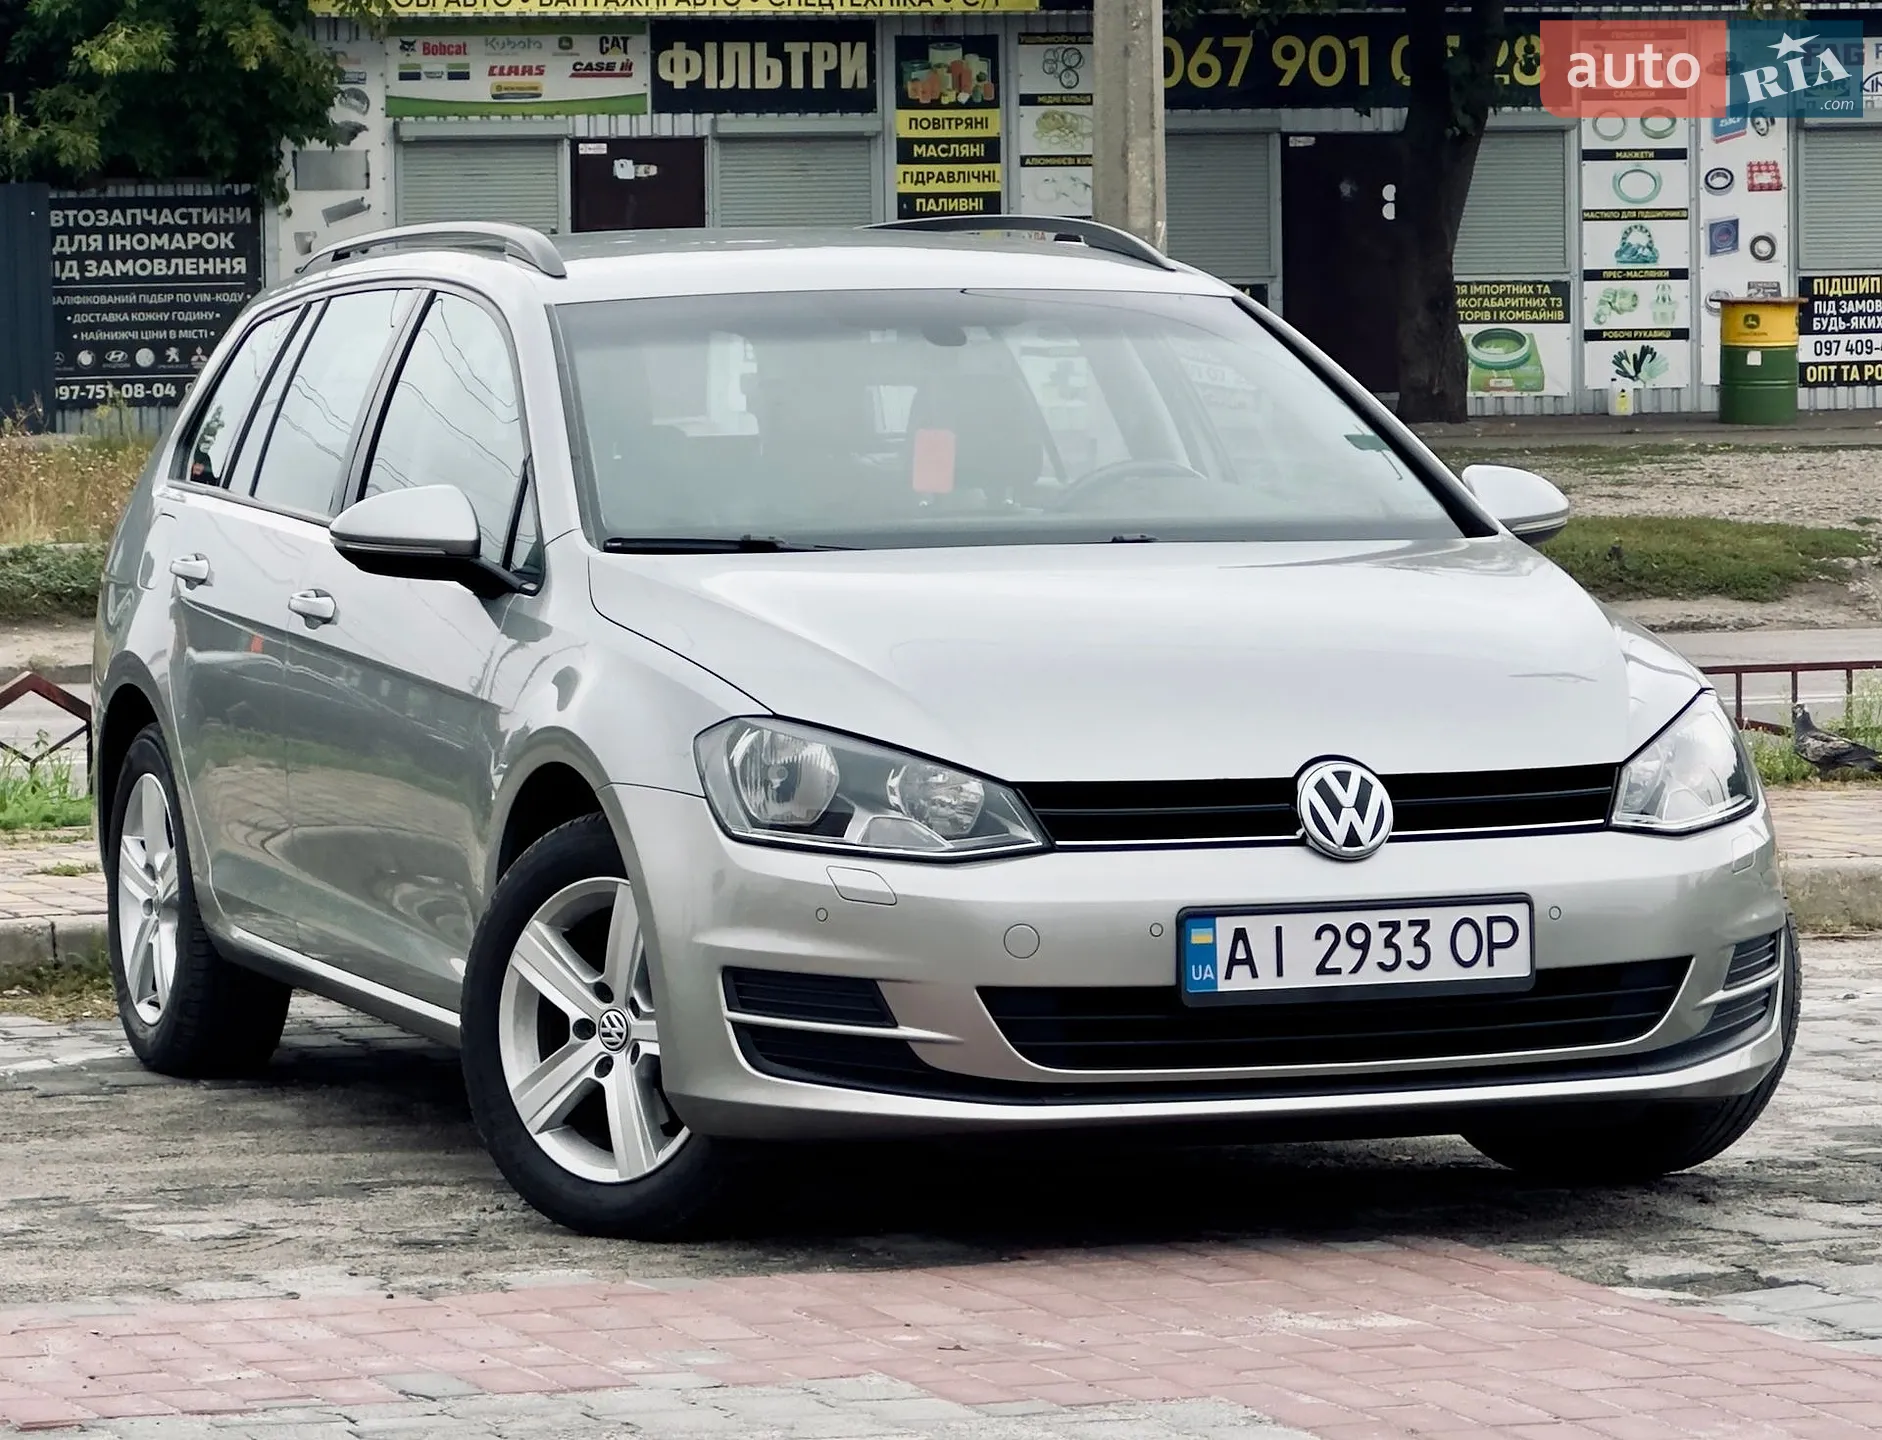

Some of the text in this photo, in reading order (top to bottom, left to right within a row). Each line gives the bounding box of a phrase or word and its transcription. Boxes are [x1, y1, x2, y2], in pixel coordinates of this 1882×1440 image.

[422, 41, 468, 56] Bobcat
[485, 36, 543, 50] Kubota
[600, 35, 631, 56] CAT
[572, 61, 617, 72] CASE
[658, 41, 868, 90] ФІЛЬТРИ
[1163, 35, 1253, 89] 067
[1272, 35, 1370, 88] 901
[488, 64, 546, 77] CLAAS
[909, 116, 989, 131] ПОВІТРЯНІ
[913, 143, 985, 158] МАСЛЯНІ
[1615, 151, 1655, 159] МАНЖЕТИ
[903, 170, 996, 187] ГІДРАВЛІЧНІ
[915, 198, 984, 212] ПАЛИВНІ
[50, 207, 251, 227] ВТОЗАПЧАСТИНИ
[1583, 211, 1620, 219] МАСТИЛО
[1621, 210, 1637, 219] ДЛЯ
[52, 232, 235, 255] ДЛЯ ІНОМАРОК
[51, 257, 247, 281] ІД ЗАМОВЛЕННЯ
[1602, 270, 1670, 279] ПРЕС-МАСЛЯНКИ
[1470, 284, 1534, 295] ІМПОРТНИХ
[1537, 284, 1551, 295] ТА
[1813, 277, 1882, 297] ПІДШИП
[53, 291, 244, 305] АЛІФІКОВАНИЙ ПІДБІР ПО VIN-КОДУ
[1493, 310, 1497, 320] І
[1499, 308, 1565, 321] КОМБАЙНІВ
[1813, 299, 1882, 315] ПІД ЗАМОВ
[72, 310, 215, 324] ДОСТАВКА КОЖНУ ГОДИНУ
[1812, 316, 1882, 332] БУДЬ-ЯКИХ
[80, 328, 208, 341] НАЙНИЖЧІ ЦІНИ В МІСТІ
[1602, 330, 1672, 339] РОБОЧІ РУКАВИЦІ
[1813, 339, 1882, 356] 097 409-
[1806, 363, 1882, 382] ОПТ ТА РО
[56, 383, 176, 400] 97-751-08-04
[1224, 915, 1520, 981] AI 2933 OP
[1192, 963, 1215, 982] UA
